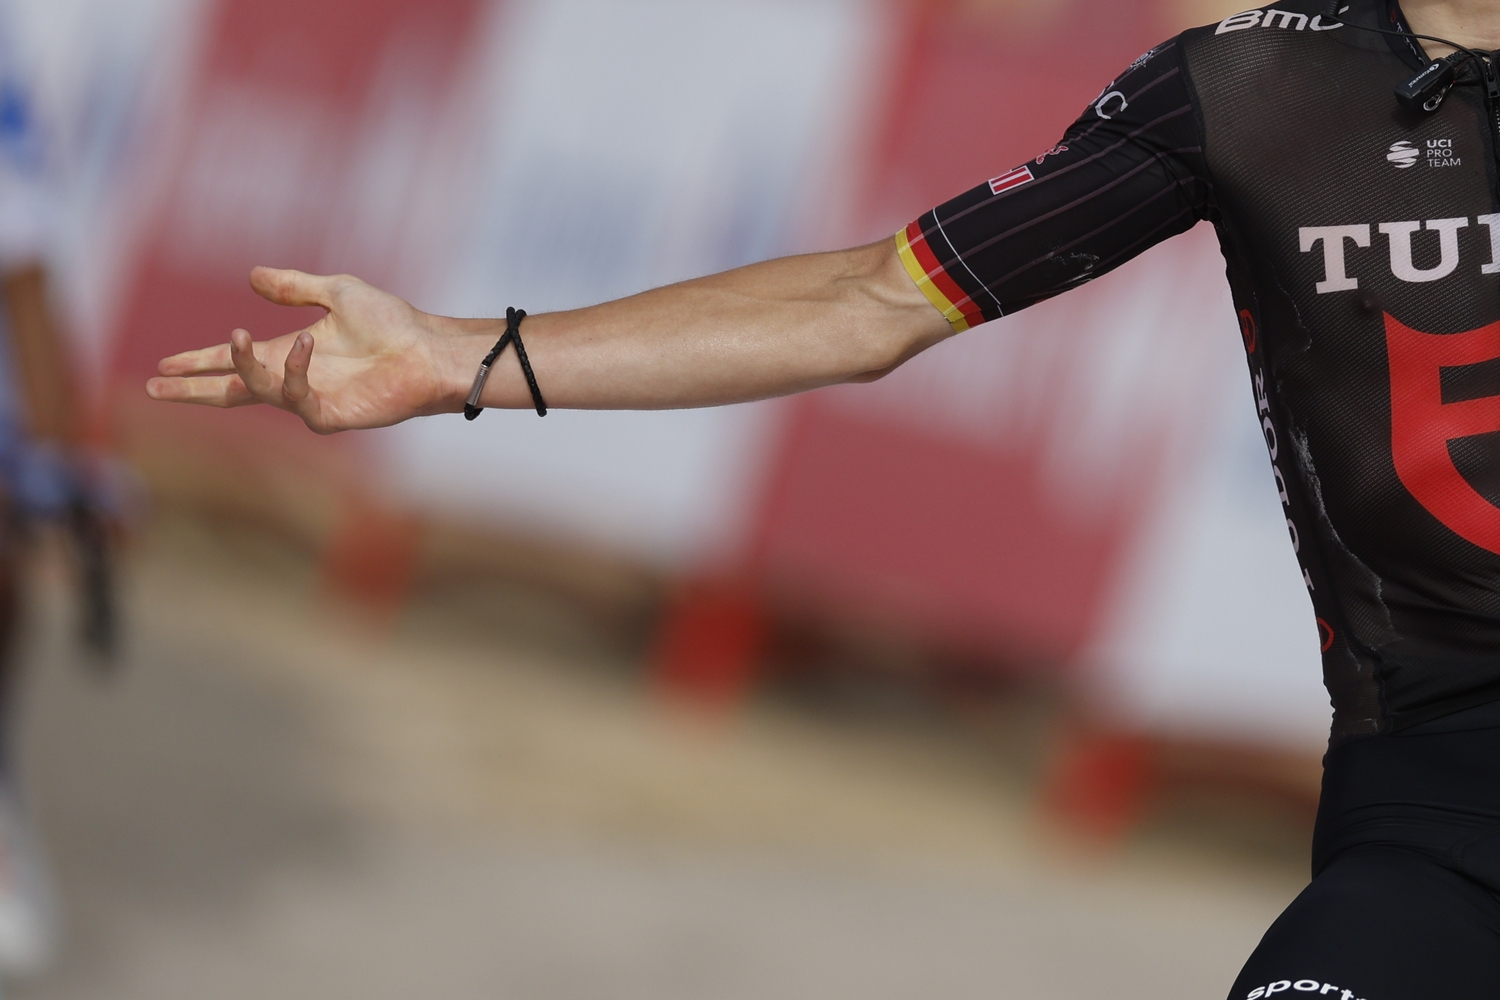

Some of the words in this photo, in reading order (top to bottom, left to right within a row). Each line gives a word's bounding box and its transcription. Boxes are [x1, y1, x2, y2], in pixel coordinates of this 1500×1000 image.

[1214, 4, 1350, 35] BMC
[1426, 139, 1452, 148] UCI
[1426, 148, 1453, 158] PRO
[1427, 158, 1461, 167] TEAM
[1246, 979, 1368, 1000] sport
